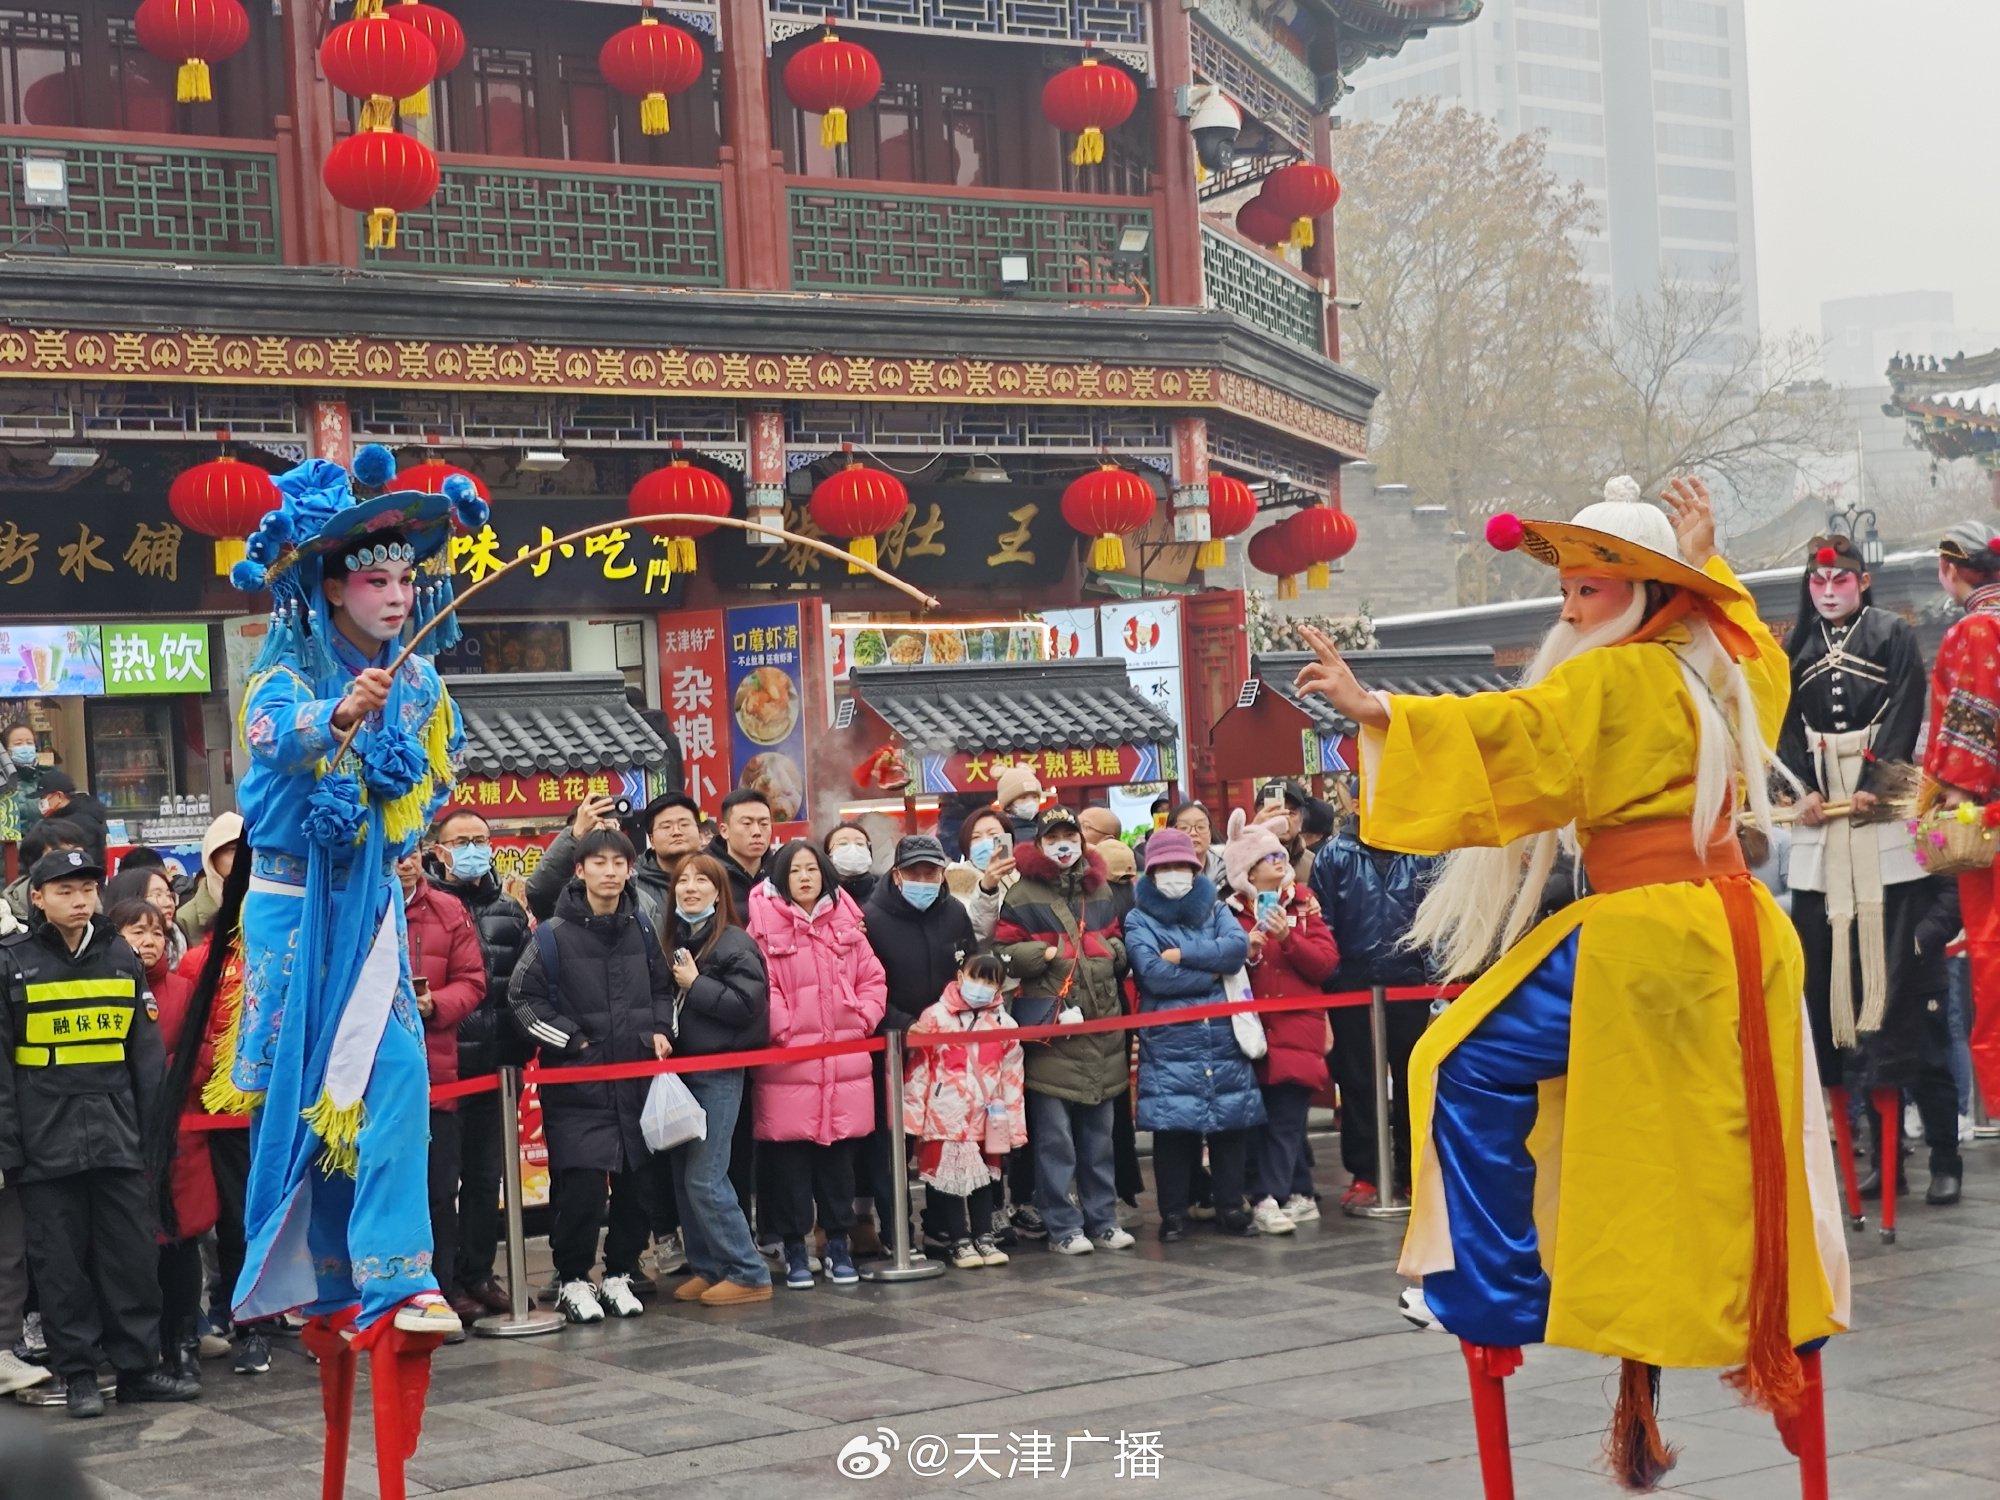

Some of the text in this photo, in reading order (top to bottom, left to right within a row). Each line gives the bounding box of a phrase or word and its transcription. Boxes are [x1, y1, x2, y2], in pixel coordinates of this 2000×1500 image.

[411, 524, 638, 584] 味小吃
[665, 626, 716, 654] 天津特产
[732, 625, 799, 652] 口蘑虾滑
[109, 632, 207, 683] 热饮
[672, 665, 718, 822] 杂粮小
[443, 775, 610, 806] 吹糖人 桂花糕
[52, 1013, 124, 1036] 融保保安
